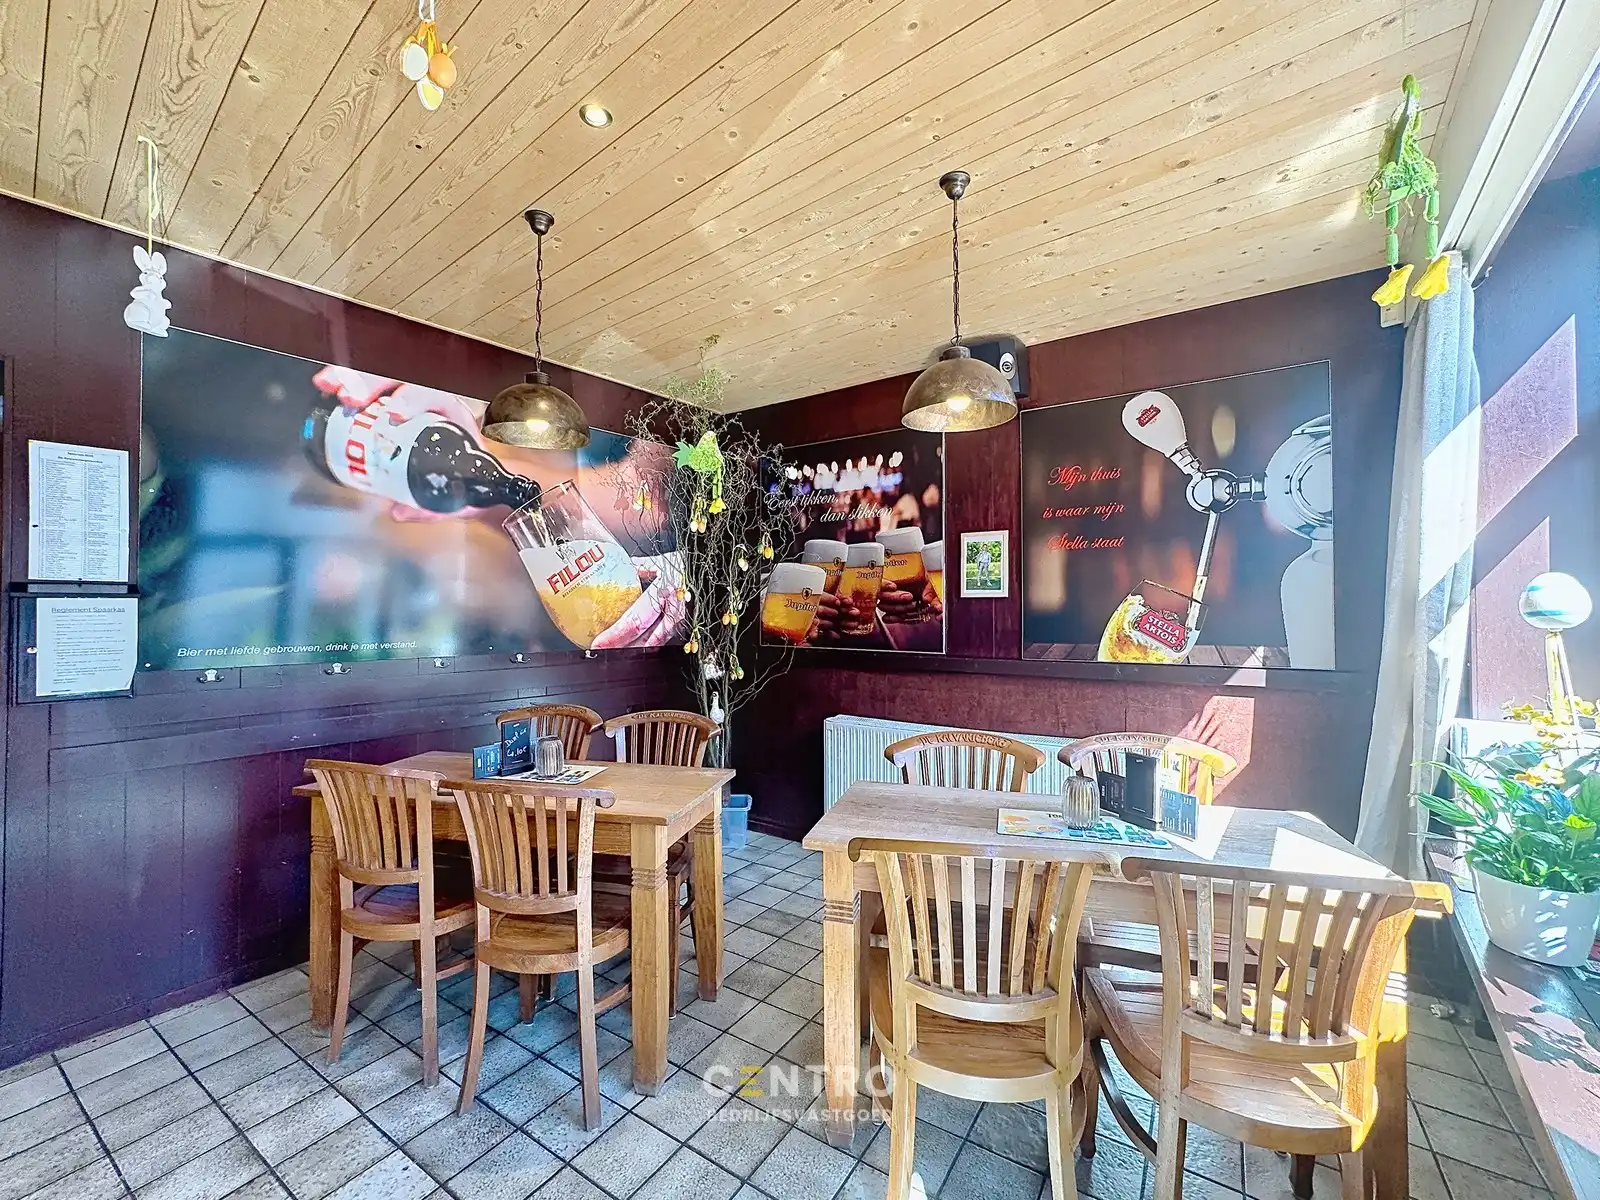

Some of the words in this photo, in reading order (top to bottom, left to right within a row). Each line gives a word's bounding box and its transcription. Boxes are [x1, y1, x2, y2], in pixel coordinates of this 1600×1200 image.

[1048, 465, 1087, 491] Mijn
[1091, 466, 1121, 480] thuis
[820, 507, 846, 522] dan
[848, 503, 893, 520] slikken
[1042, 507, 1053, 518] is
[1055, 506, 1090, 517] waar
[1093, 502, 1125, 521] mijn
[1048, 532, 1088, 550] Stella
[1091, 536, 1125, 549] staat
[547, 544, 605, 595] FILOU
[1143, 623, 1177, 644] ARTOIS
[1147, 615, 1179, 637] STELLA
[177, 647, 203, 657] Bier
[205, 647, 228, 656] met
[230, 645, 261, 655] liefde
[263, 645, 322, 656] gebrouwen,
[325, 643, 349, 652] drink
[349, 642, 359, 652] je
[361, 642, 378, 650] met
[380, 641, 416, 649] verstand.
